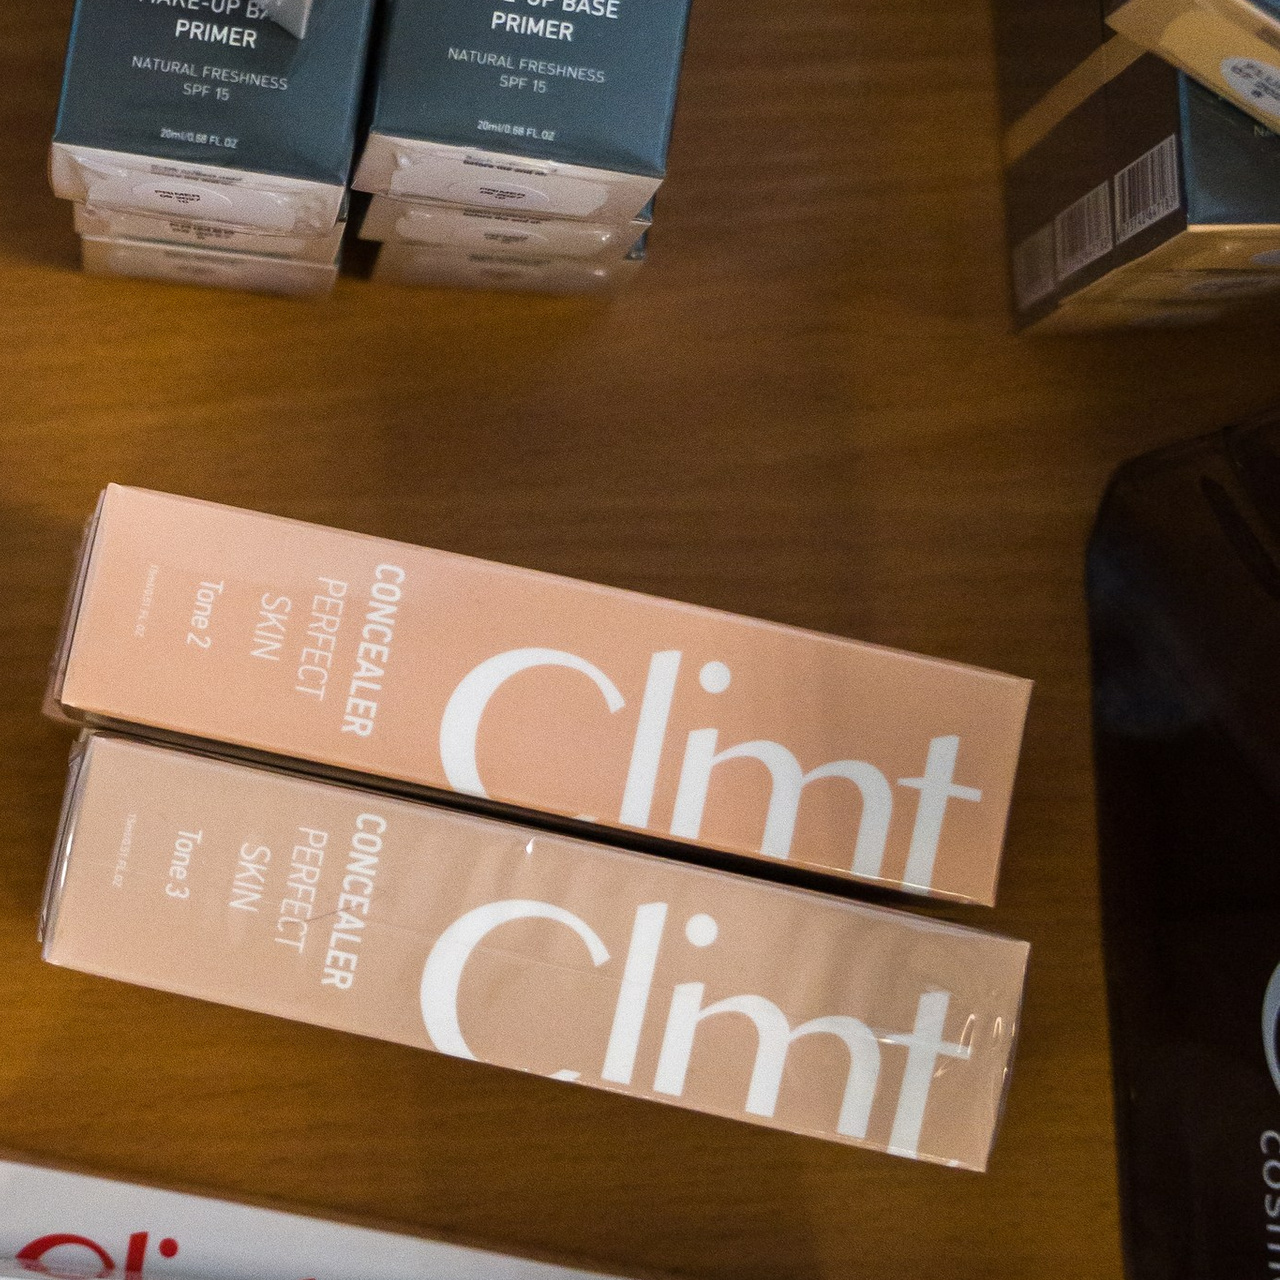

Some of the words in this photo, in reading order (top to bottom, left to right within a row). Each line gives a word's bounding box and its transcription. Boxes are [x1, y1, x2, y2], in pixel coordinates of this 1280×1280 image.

[174, 18, 258, 50] PRIMER
[490, 11, 575, 42] PRIMER
[131, 55, 198, 78] NATURAL
[202, 66, 289, 91] FRESHNESS
[447, 46, 516, 70] NATURAL
[518, 58, 606, 84] FRESHNESS
[498, 74, 528, 91] SPF
[532, 79, 548, 94] 15
[182, 83, 211, 99] SPF
[215, 87, 231, 102] 15
[190, 579, 225, 631] Tone
[249, 592, 293, 662] SKIN
[186, 631, 213, 651] 2
[295, 576, 350, 702] PERFECT
[340, 562, 407, 738] CONCEALER
[438, 646, 983, 897] Climt
[168, 828, 203, 880] Tone
[227, 841, 272, 913] SKIN
[165, 881, 191, 900] 3
[274, 825, 329, 955] PERFECT
[320, 812, 388, 991] CONCEALER
[420, 898, 972, 1158] Climt
